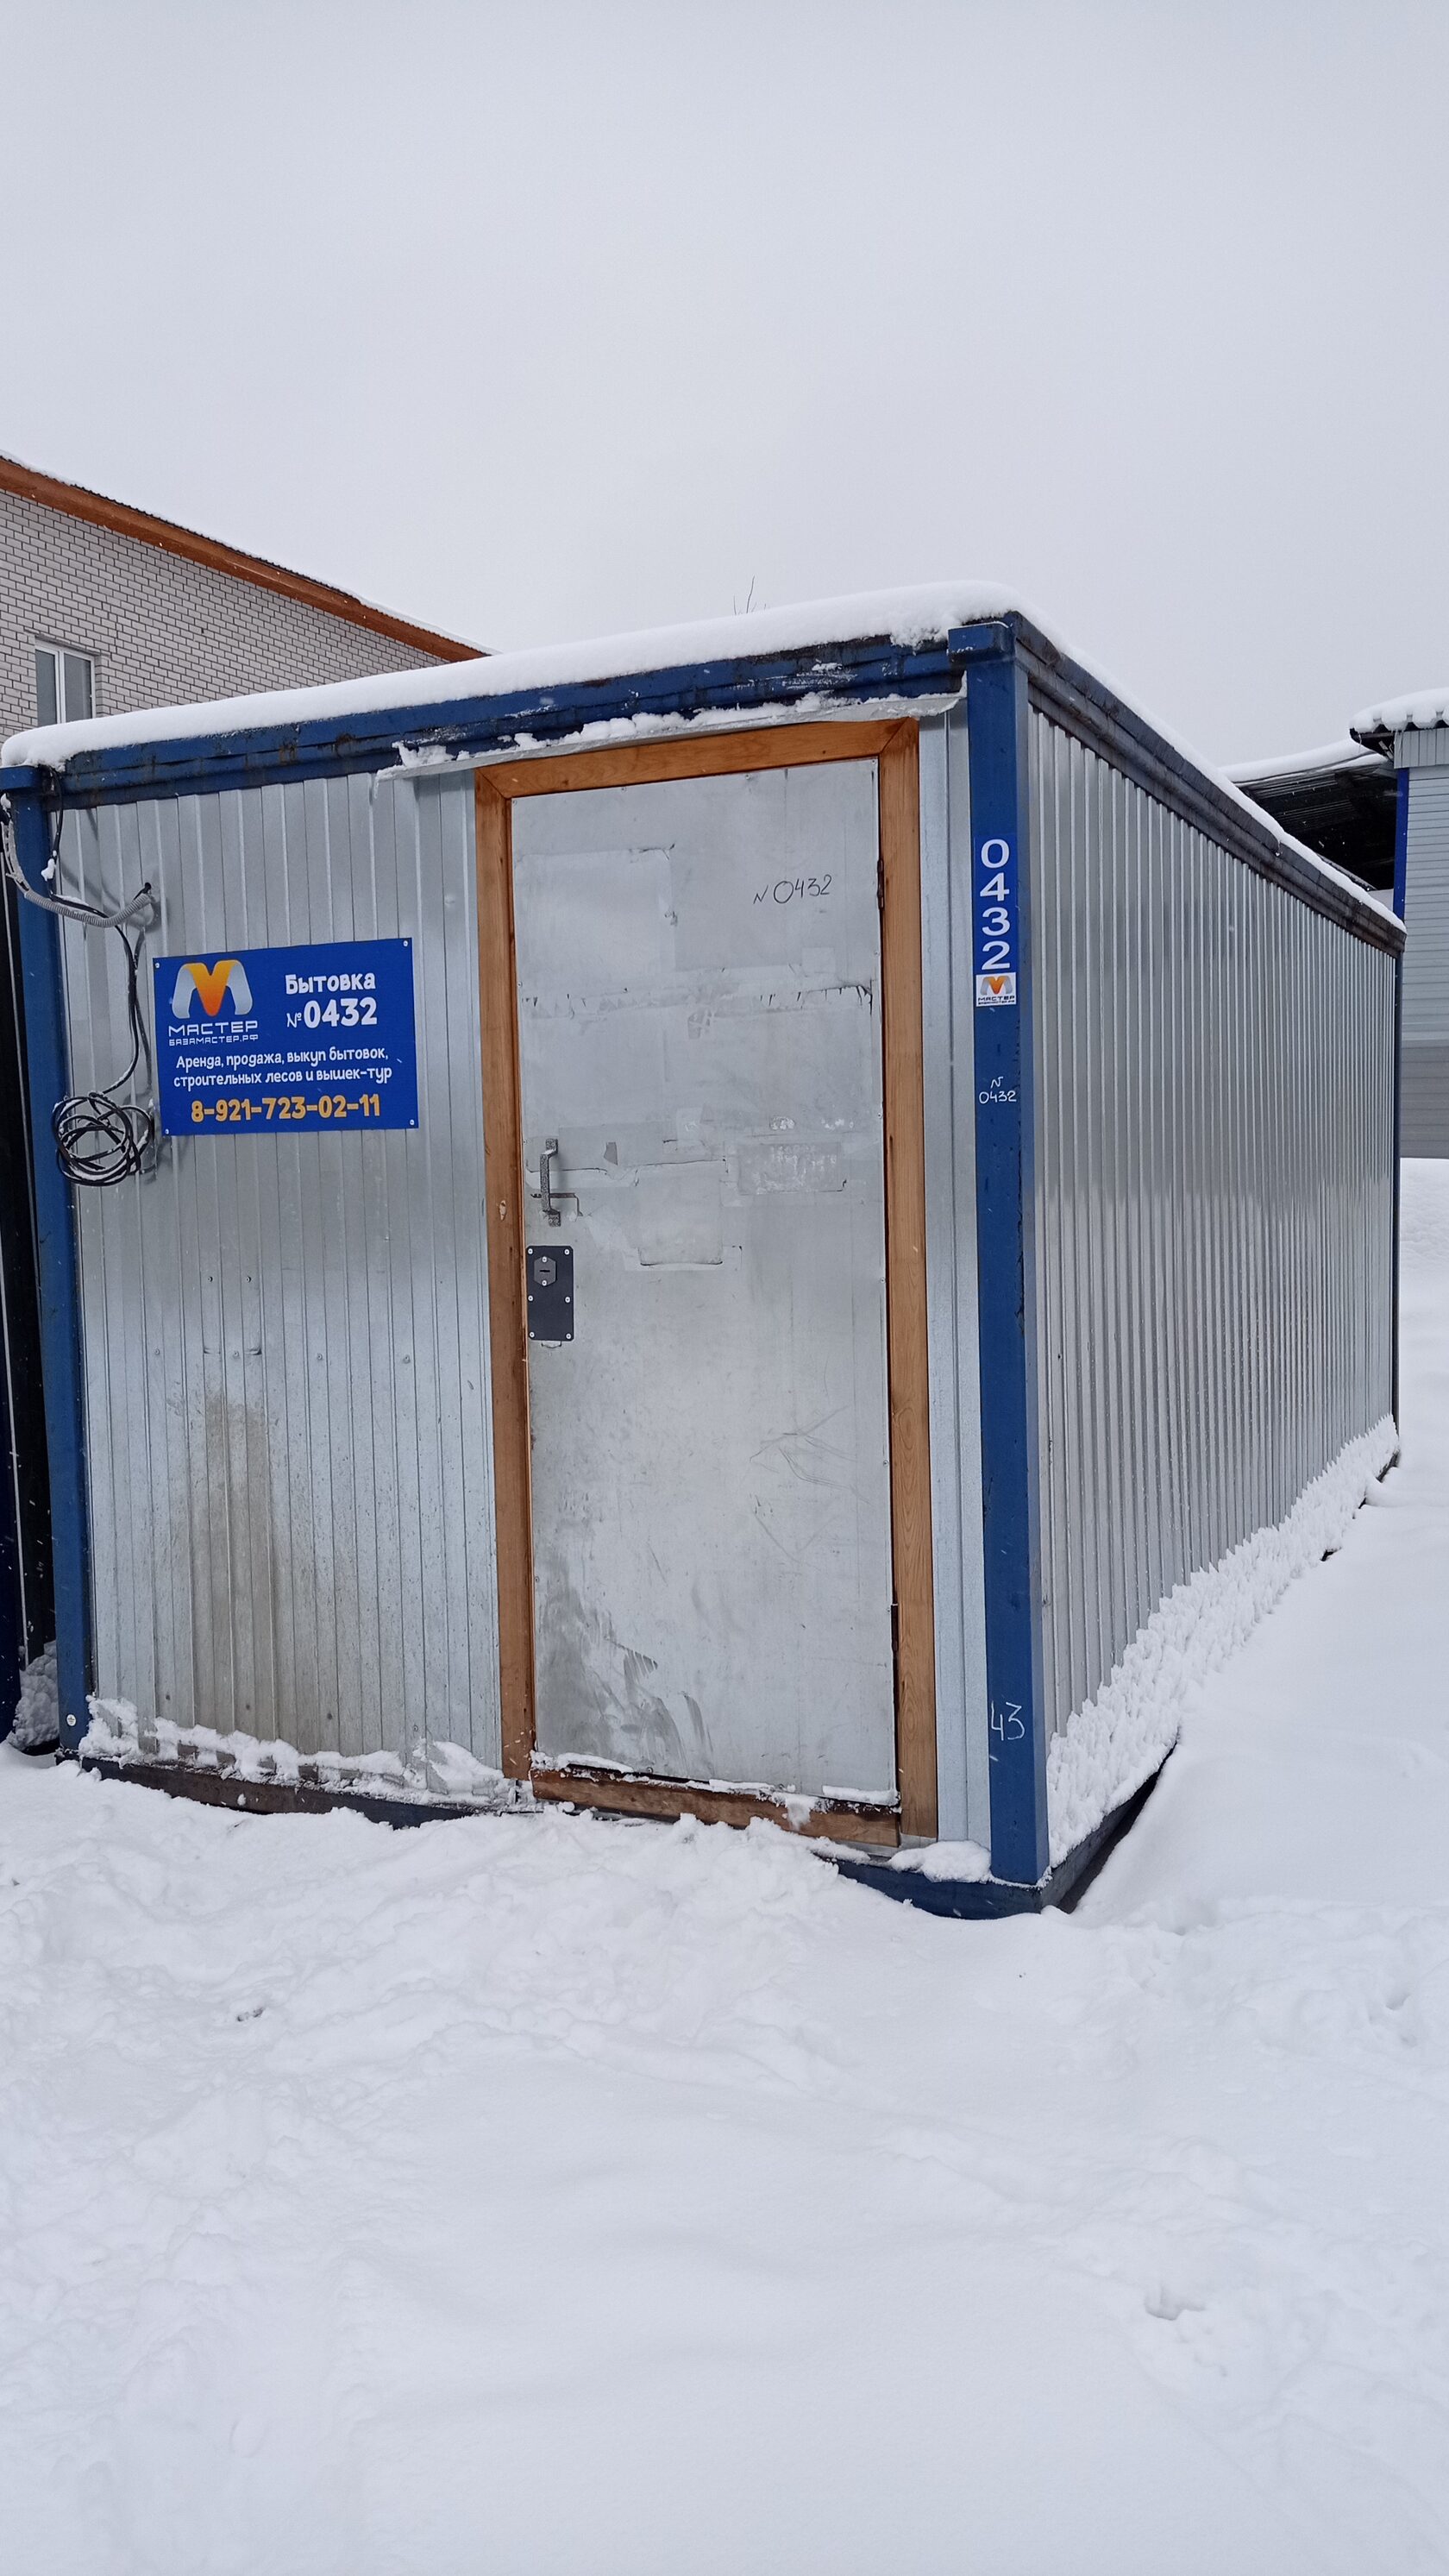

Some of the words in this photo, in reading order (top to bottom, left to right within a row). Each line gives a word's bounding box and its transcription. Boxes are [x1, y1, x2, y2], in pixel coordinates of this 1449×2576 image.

[773, 874, 832, 904] 0432
[980, 839, 1011, 971] 0432
[285, 972, 376, 995] Бытовка
[168, 1020, 258, 1037] МАСТЕР
[169, 1034, 259, 1046] БАЗАМАСТЕР.РФ
[176, 1055, 224, 1073] Аренда,
[226, 1052, 285, 1071] продажа,
[286, 1051, 327, 1067] выкуп
[329, 1046, 388, 1061] бытовок,
[173, 1071, 262, 1092] строительных
[265, 1070, 303, 1084] лесов
[305, 1070, 314, 1082] и
[316, 1066, 392, 1084] вышек-тур
[191, 1094, 380, 1122] 8-921-723-02-11
[979, 1090, 1017, 1104] 0432
[991, 1700, 1026, 1741] 43
